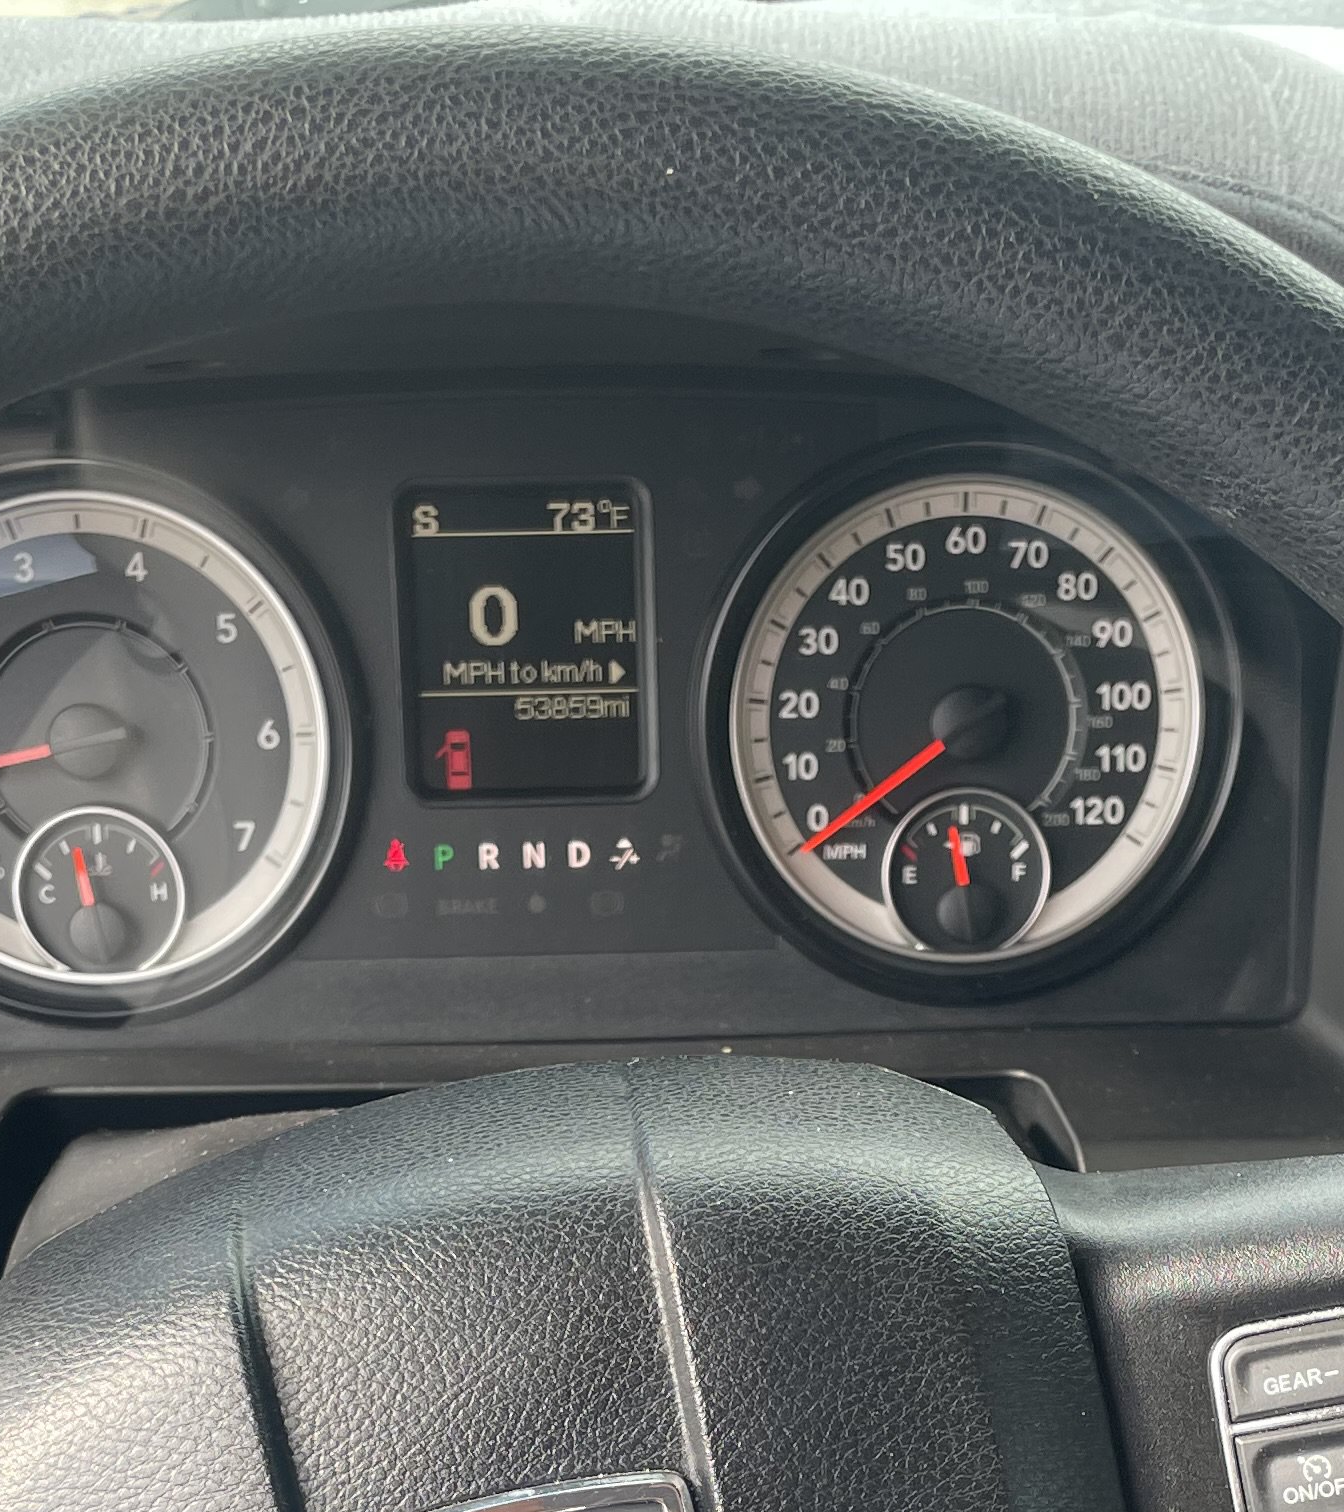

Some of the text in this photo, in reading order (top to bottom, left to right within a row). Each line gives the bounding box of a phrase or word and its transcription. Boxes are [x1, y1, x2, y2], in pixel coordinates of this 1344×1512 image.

[412, 504, 440, 535] S
[946, 525, 986, 555] 60
[1008, 540, 1049, 570] 70
[13, 552, 35, 582] 3
[125, 551, 149, 582] 4
[885, 542, 926, 572] 50
[829, 576, 870, 606] 40
[1057, 572, 1098, 602] 80
[216, 613, 238, 644] 5
[469, 584, 519, 647] 0
[574, 619, 636, 644] MPH
[798, 626, 839, 656] 30
[1091, 619, 1133, 649] 90
[443, 659, 603, 685] MPH to km/h
[778, 689, 820, 720] 20
[1096, 681, 1152, 712] 100
[257, 719, 281, 751] 6
[782, 750, 819, 781] 10
[1096, 743, 1147, 773] 110
[806, 803, 829, 833] 0
[1069, 795, 1125, 825] 120
[232, 821, 255, 851] 7
[433, 840, 591, 871] P R N D
[822, 843, 867, 860] MPH
[902, 865, 918, 885] E
[1011, 863, 1027, 882] F
[38, 884, 56, 904] C
[150, 881, 168, 902] H
